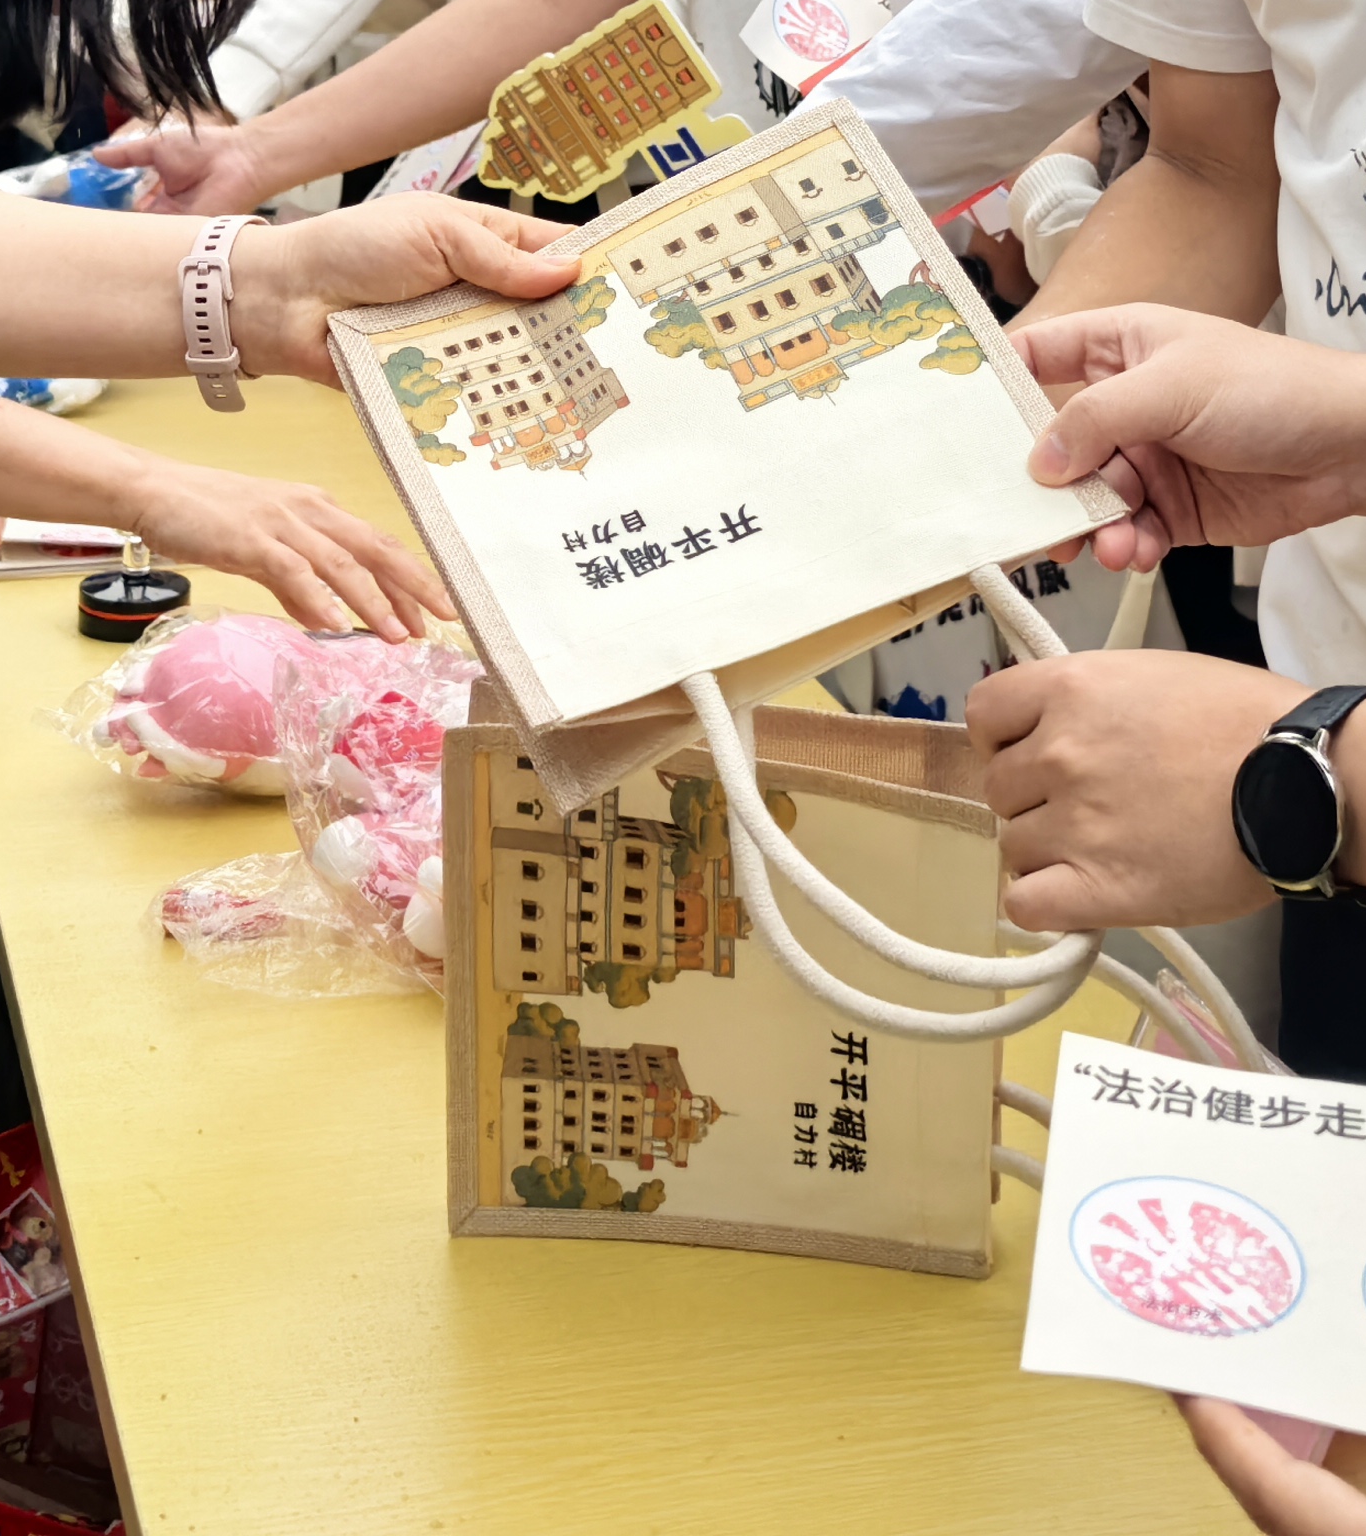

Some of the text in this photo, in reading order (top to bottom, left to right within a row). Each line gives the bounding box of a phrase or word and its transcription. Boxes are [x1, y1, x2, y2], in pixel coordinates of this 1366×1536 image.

[561, 509, 647, 553] 自力村
[575, 503, 763, 590] 开平碉楼
[793, 1101, 819, 1170] 自力村
[827, 1029, 869, 1173] 开平碉楼
